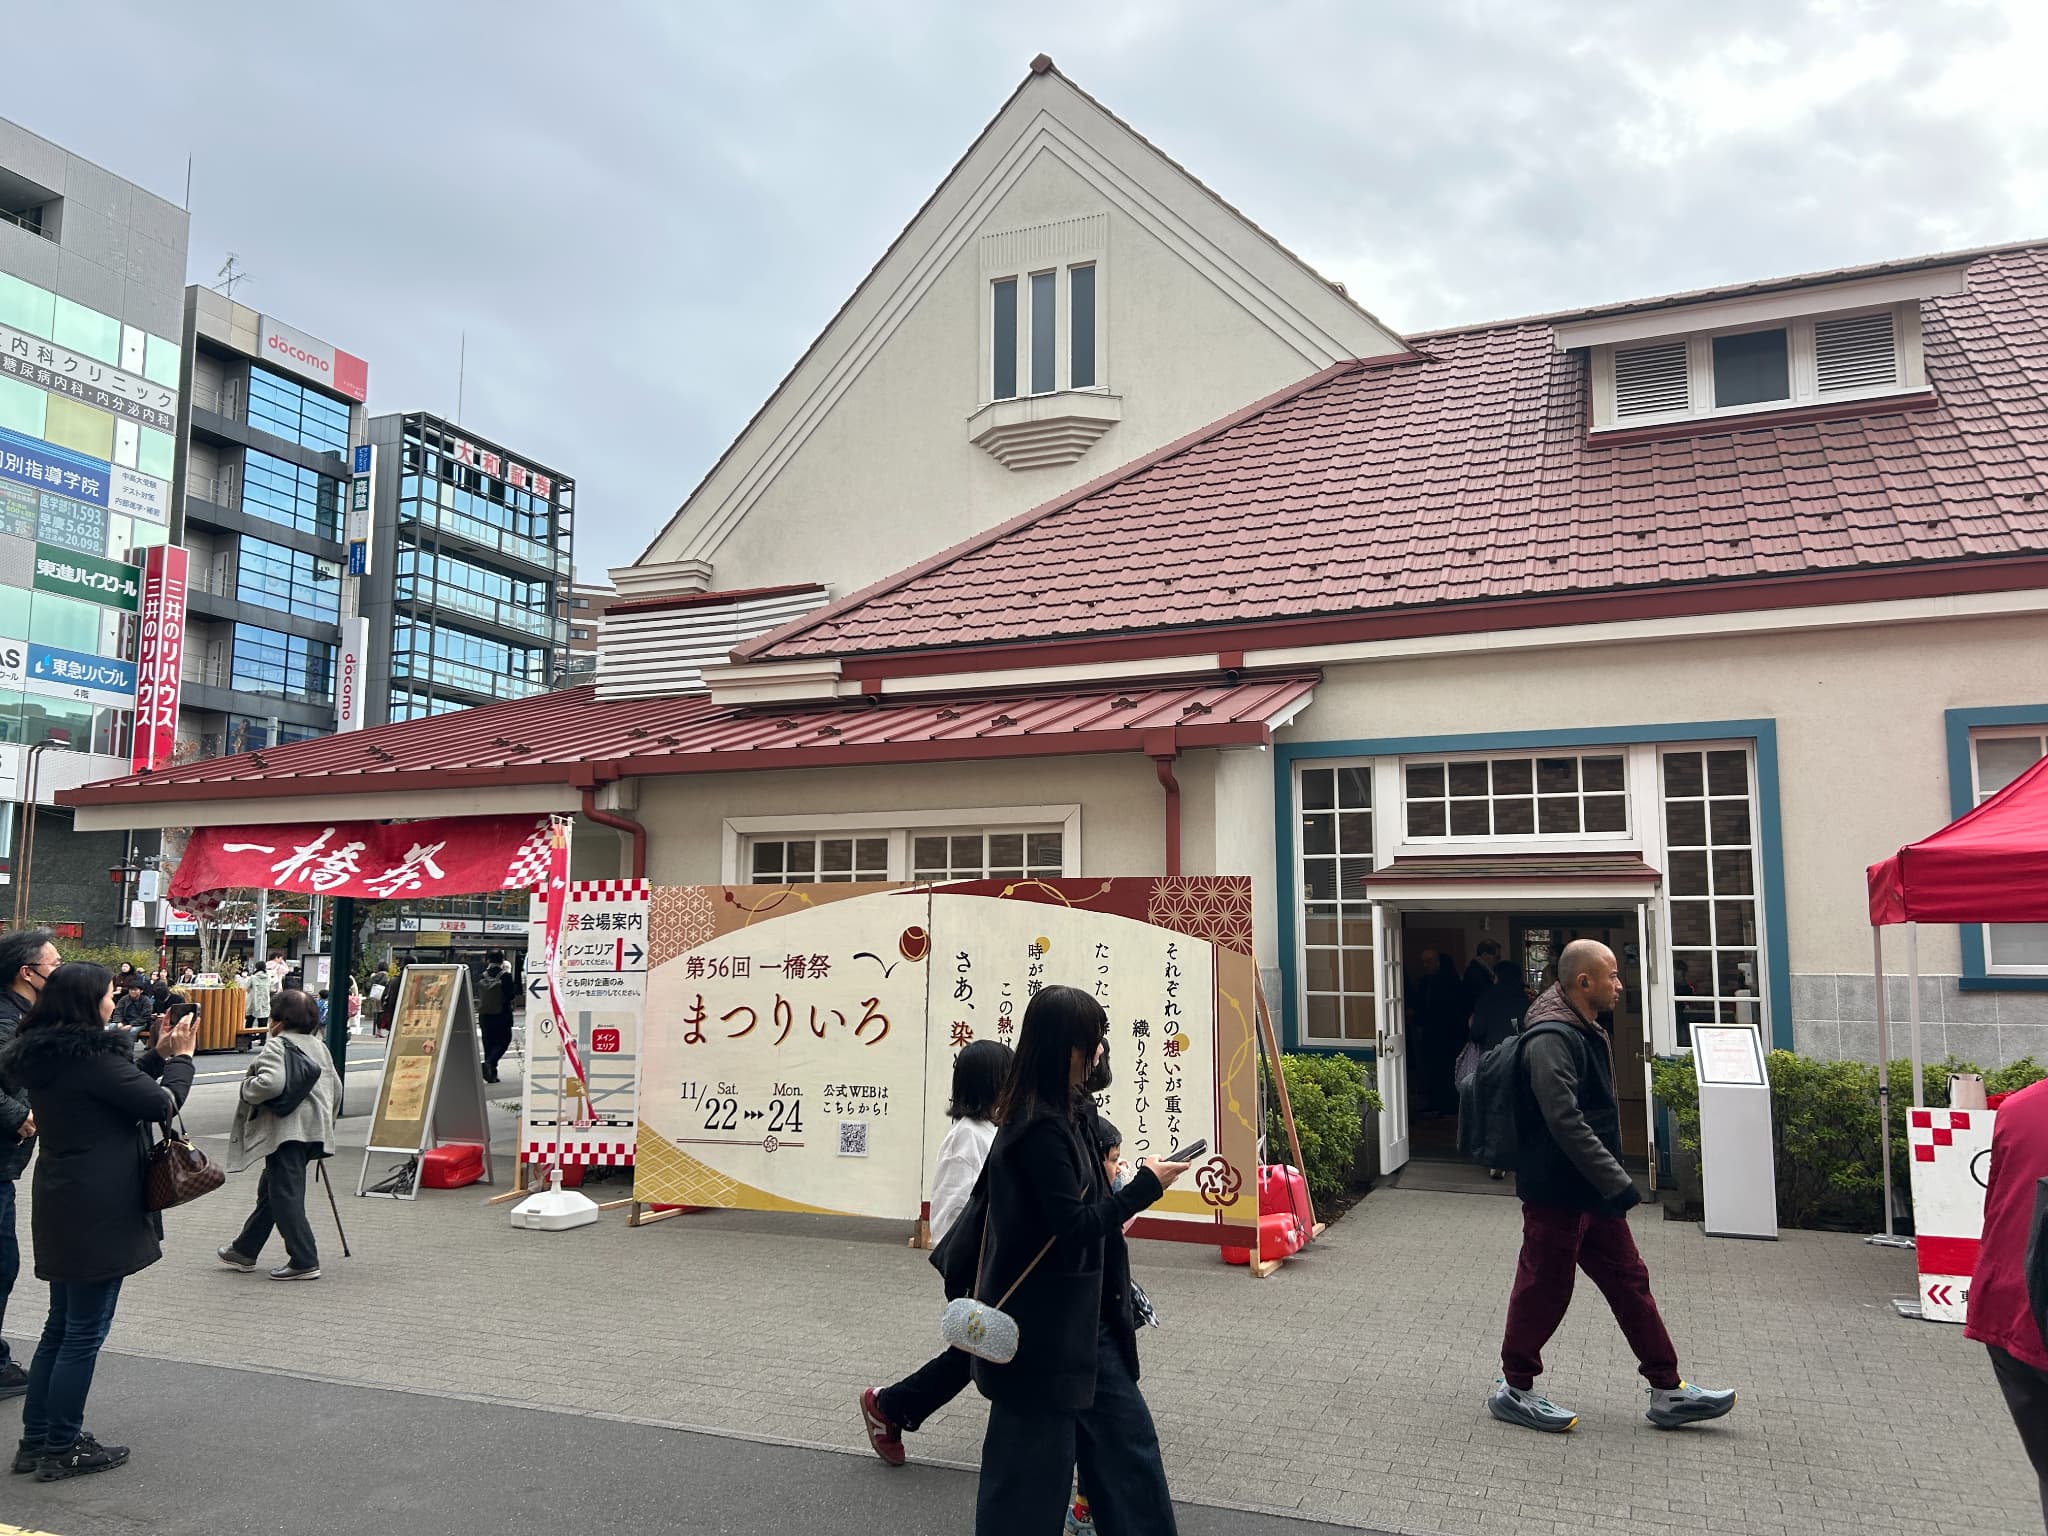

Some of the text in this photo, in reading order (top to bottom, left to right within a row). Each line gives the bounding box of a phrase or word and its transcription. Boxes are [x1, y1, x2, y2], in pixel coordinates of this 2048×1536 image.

[0, 332, 171, 408] 内科クリニック
[268, 334, 330, 372] docomo
[3, 355, 170, 427] 糖尿病内科・内分泌内科
[457, 440, 550, 497] 大和証券
[36, 558, 137, 597] 東進ハイスクール
[137, 578, 161, 726] 三井のリハウス
[157, 578, 183, 728] 三井のリハウス
[52, 657, 129, 687] 東急リバブル
[341, 653, 356, 721] docomo
[223, 827, 447, 898] 一橋祭
[533, 912, 643, 932] 一祭会場案内
[560, 943, 615, 956] インエリア
[685, 952, 833, 981] 第56回 一橋祭
[561, 977, 625, 987] ども向け企画のみ
[682, 992, 891, 1047] まつりいろ
[950, 951, 975, 1068] さあ、染
[1163, 942, 1183, 1154] それぞれの想いが重なり
[717, 1081, 804, 1097] Sat. Mon.
[823, 1083, 889, 1099] 公式WEBは
[823, 1100, 888, 1117] こちらから！
[704, 1097, 804, 1134] 22 24
